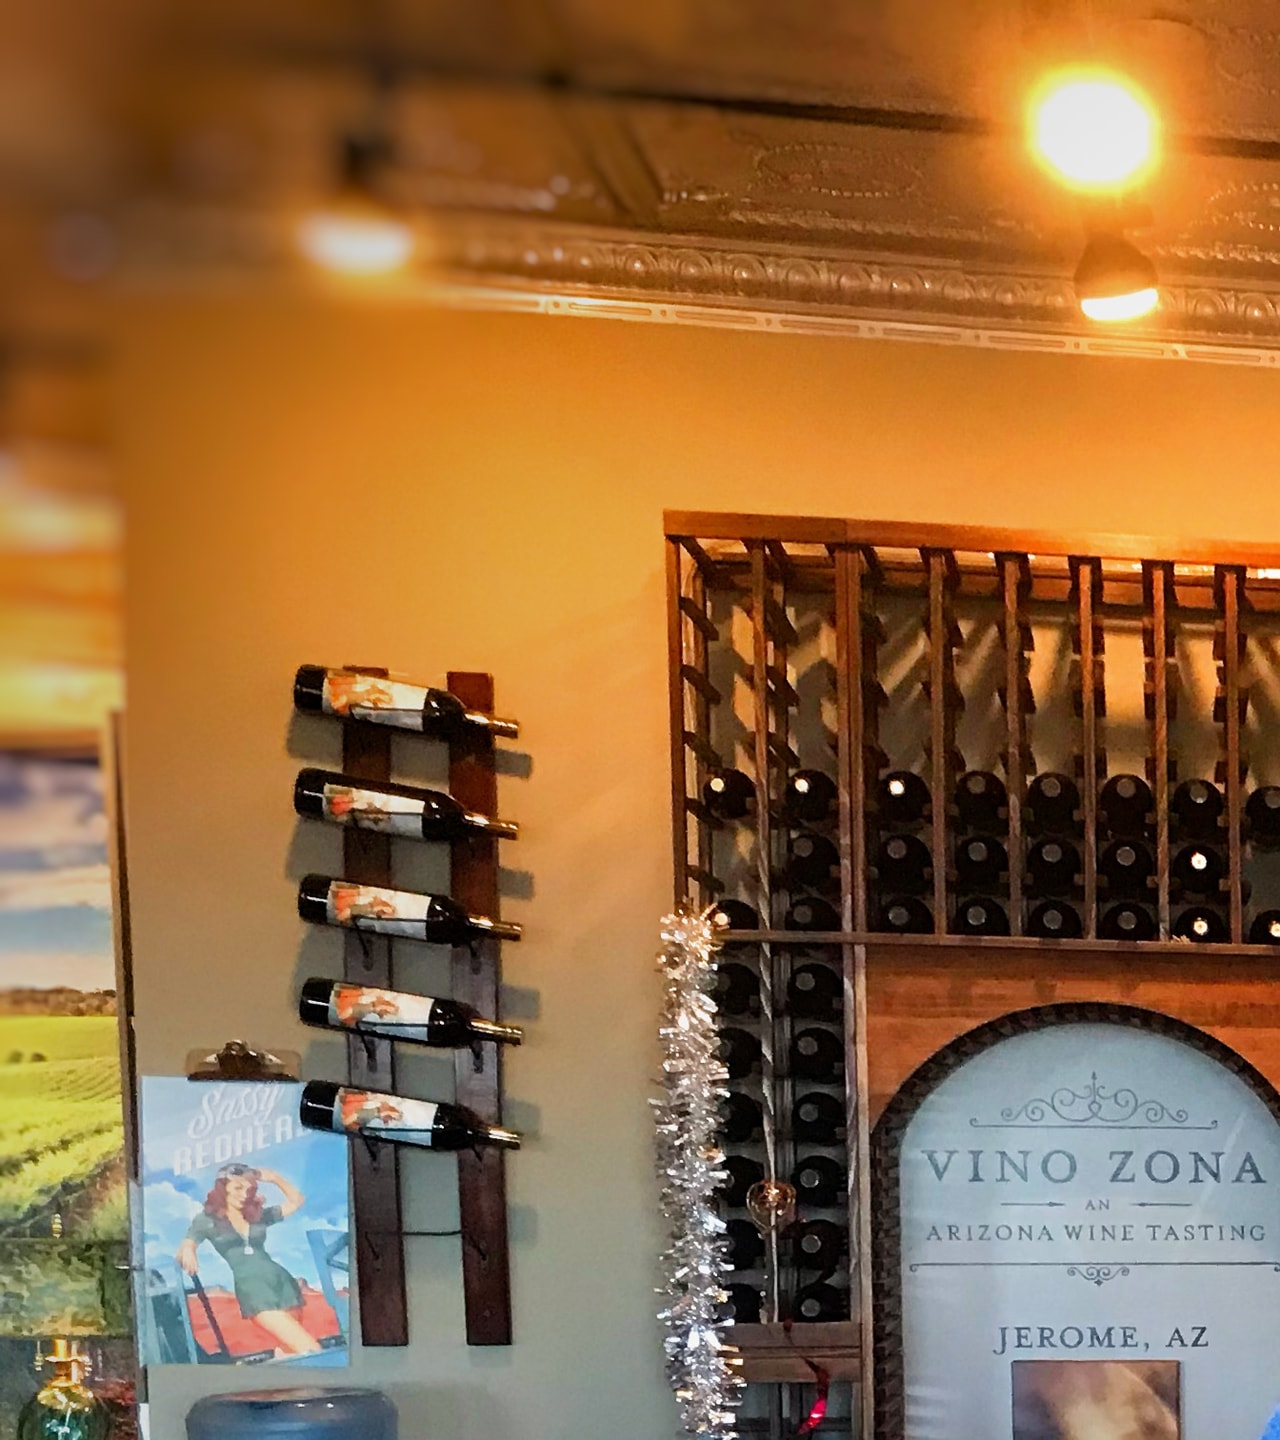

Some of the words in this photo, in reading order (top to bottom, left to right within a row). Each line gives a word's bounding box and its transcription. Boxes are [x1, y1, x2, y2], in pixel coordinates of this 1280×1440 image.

[187, 1083, 286, 1139] Sassy
[921, 1150, 1078, 1184] VINO
[1109, 1150, 1267, 1184] ZONA
[1085, 1200, 1110, 1211] AN
[926, 1224, 1054, 1242] ARIZONA
[1064, 1224, 1135, 1242] WINE
[1146, 1225, 1266, 1242] TASTING
[993, 1326, 1151, 1355] JEROME,
[1165, 1327, 1210, 1348] AZ
